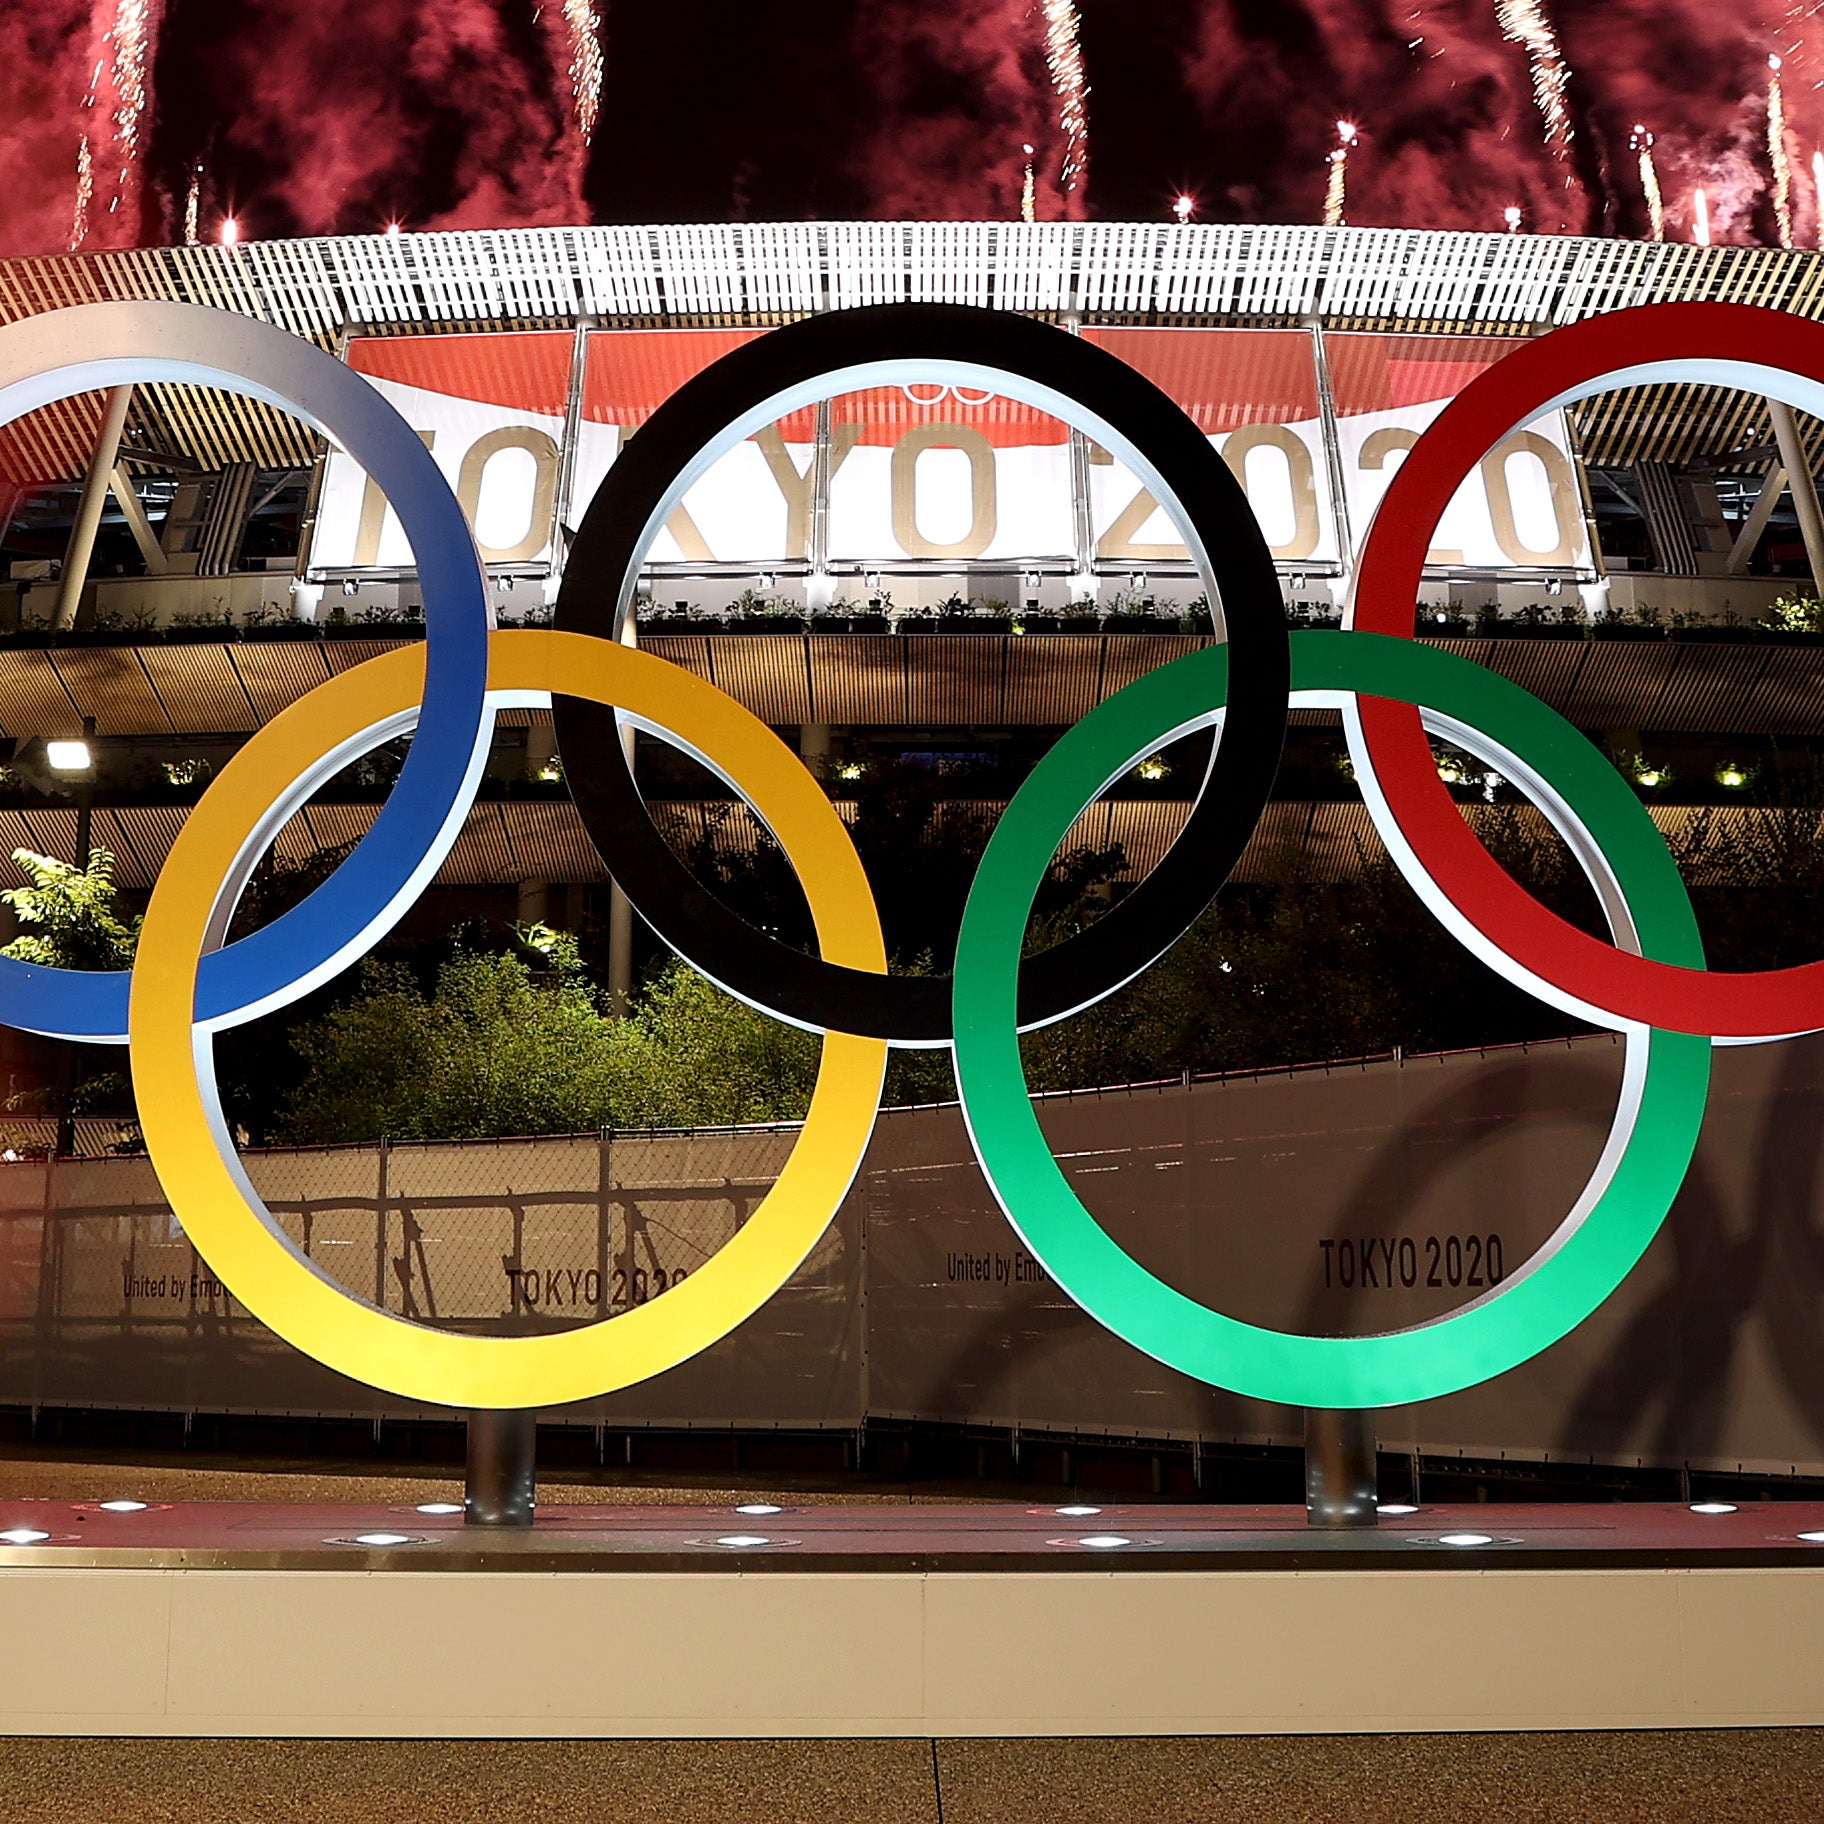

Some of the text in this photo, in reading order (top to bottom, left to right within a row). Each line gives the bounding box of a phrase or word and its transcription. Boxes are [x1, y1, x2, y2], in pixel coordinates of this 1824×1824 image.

[947, 1253, 990, 1281] United
[996, 1253, 1011, 1287] by
[1319, 1234, 1504, 1288] TOKYO 2020
[123, 1275, 166, 1298] United
[171, 1276, 186, 1301] by
[505, 1269, 601, 1305] TOKYO
